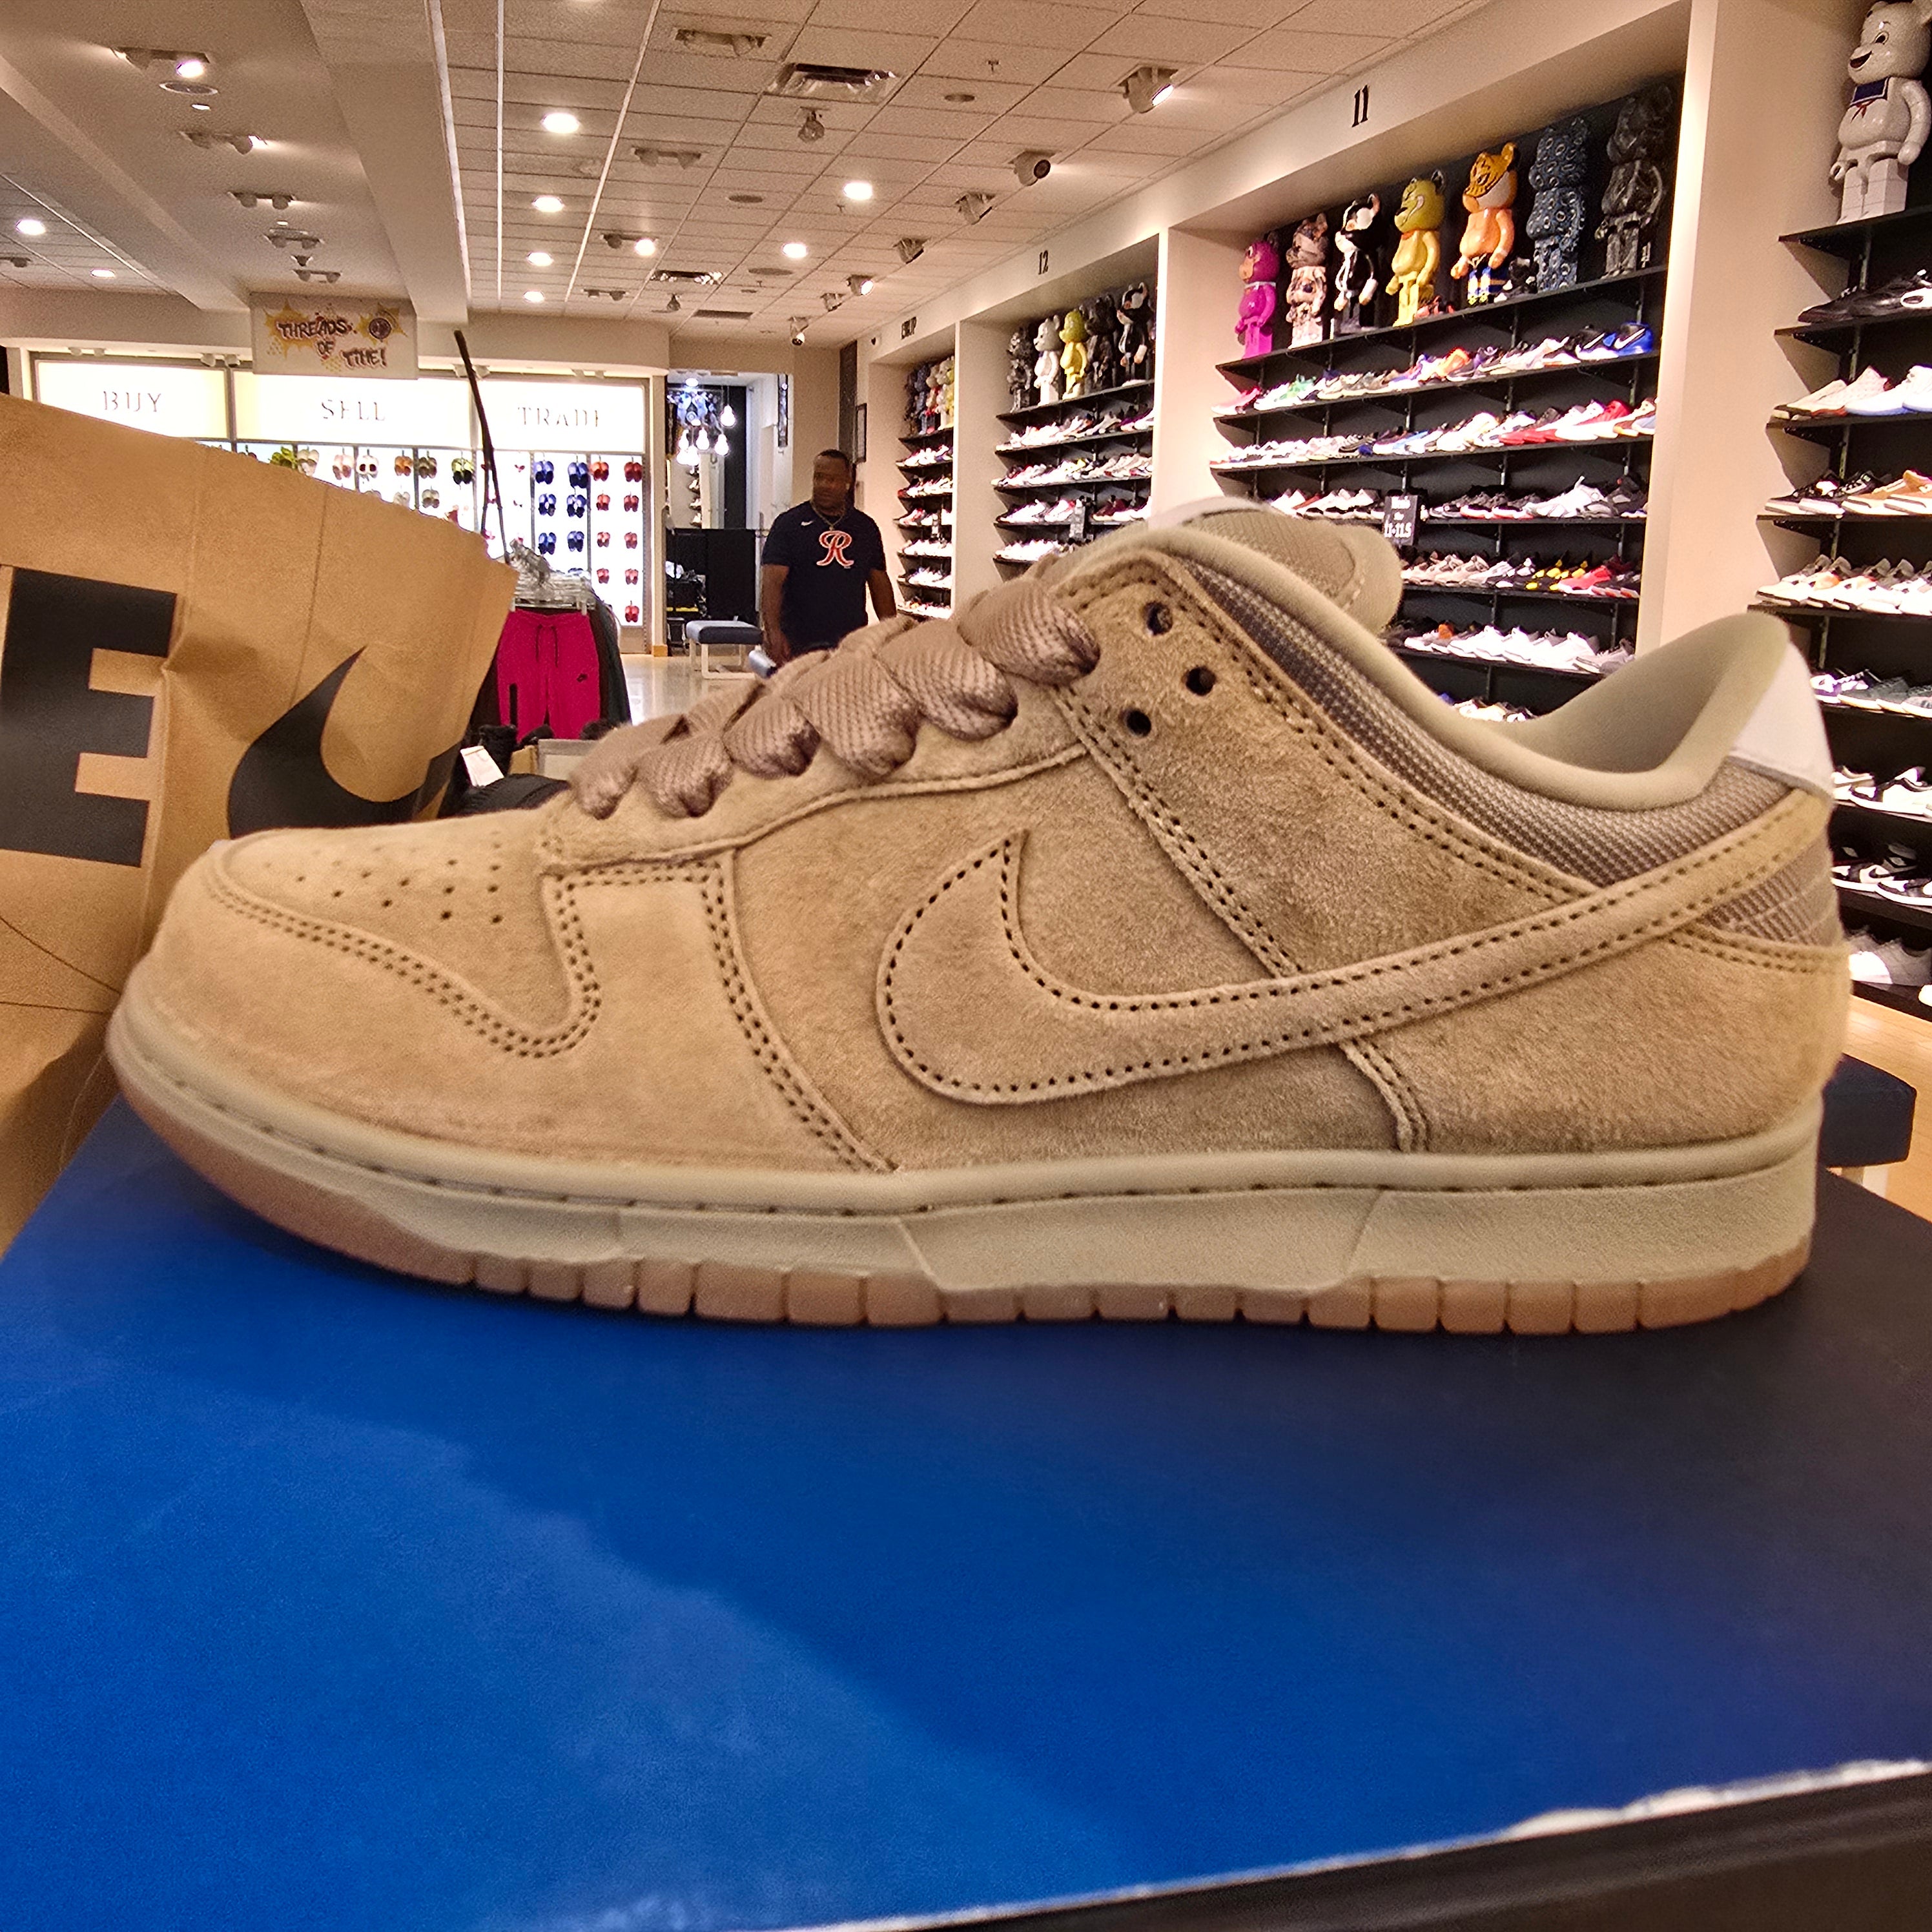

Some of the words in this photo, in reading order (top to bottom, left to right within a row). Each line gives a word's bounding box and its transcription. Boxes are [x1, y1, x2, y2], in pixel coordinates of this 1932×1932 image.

[1351, 84, 1369, 128] 11
[1038, 250, 1049, 275] 12
[276, 318, 348, 339] THREADS
[316, 340, 334, 356] OF
[341, 347, 387, 369] TIME!
[103, 391, 161, 413] BUY
[322, 398, 386, 421] SELL
[518, 406, 599, 427] TRADE
[816, 530, 854, 567] R
